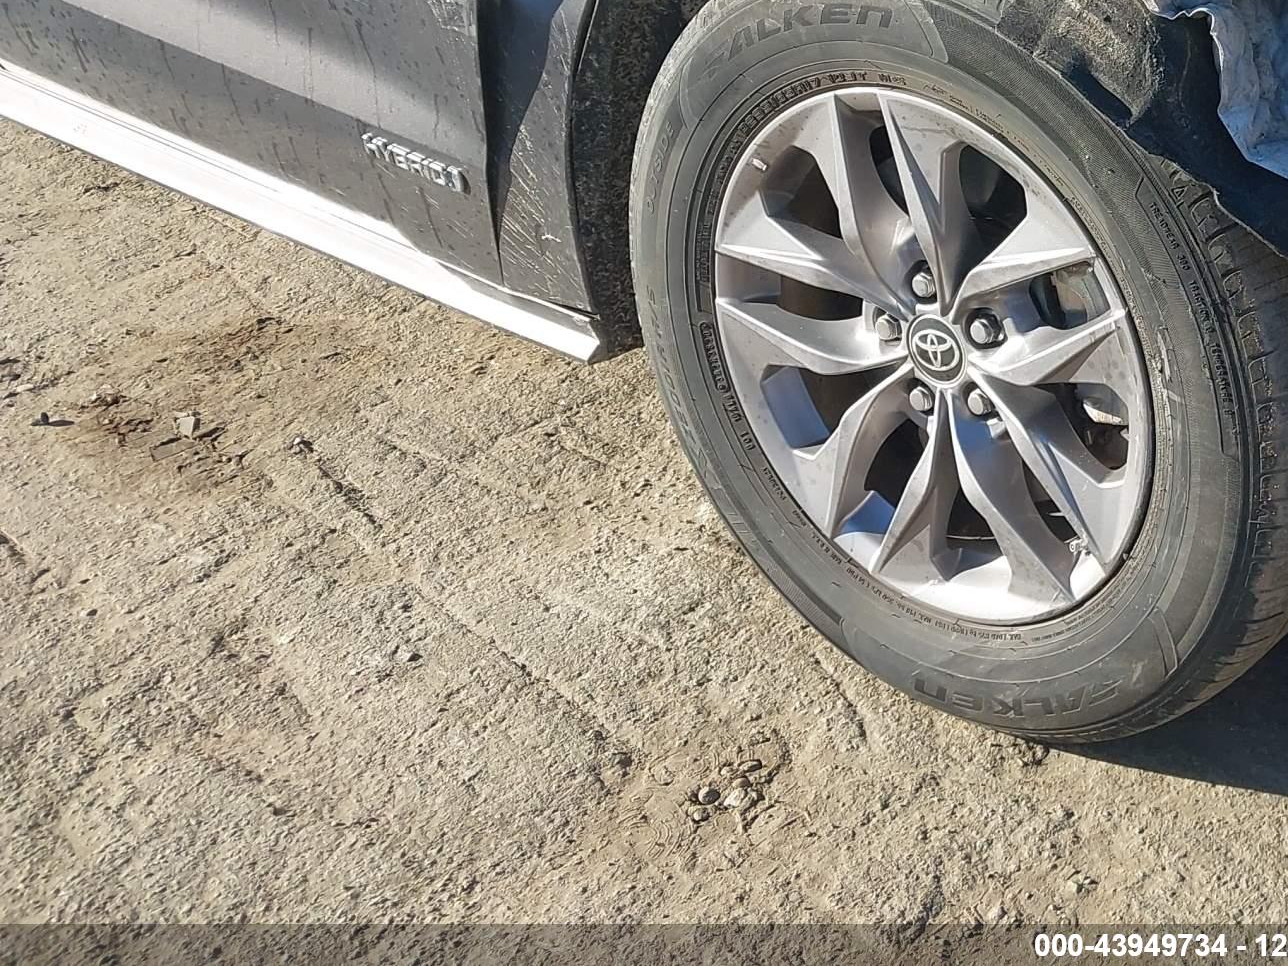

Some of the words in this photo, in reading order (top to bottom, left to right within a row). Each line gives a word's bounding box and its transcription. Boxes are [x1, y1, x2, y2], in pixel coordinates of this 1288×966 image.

[704, 2, 893, 70] FALKEN
[361, 132, 469, 194] HYBRID
[914, 679, 1122, 718] FALKEN
